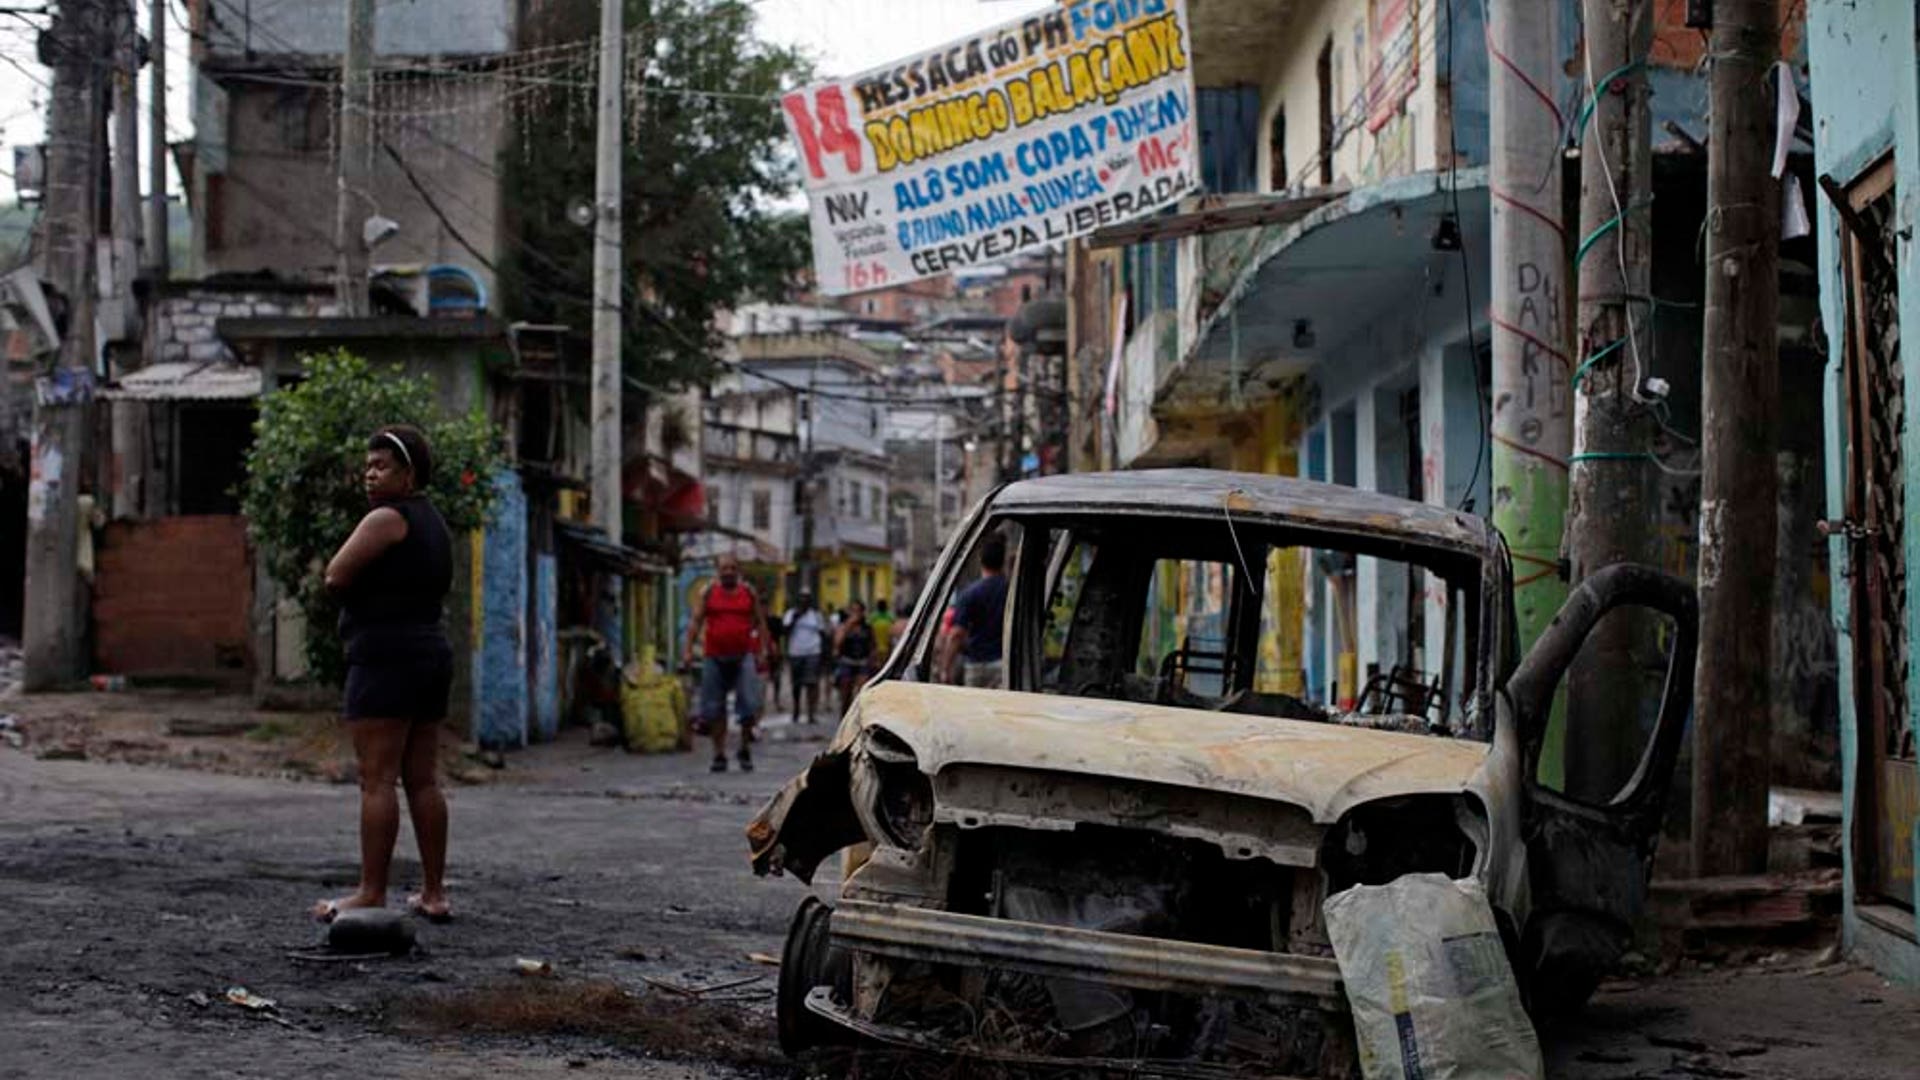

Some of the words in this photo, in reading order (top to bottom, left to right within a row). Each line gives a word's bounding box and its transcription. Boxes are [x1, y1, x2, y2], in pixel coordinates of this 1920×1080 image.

[855, 38, 987, 114] RESSACA
[988, 35, 1018, 69] do
[864, 88, 1009, 173] DOMINGO
[1004, 10, 1186, 127] BALAÇANTE
[783, 85, 862, 180] 14
[894, 166, 944, 212] ALÔ
[945, 152, 1010, 196] SOM
[897, 208, 966, 250] BRUNO
[966, 192, 1027, 233] MAIA
[1024, 165, 1105, 215] DUNGA
[911, 224, 1039, 275] CERVEJA
